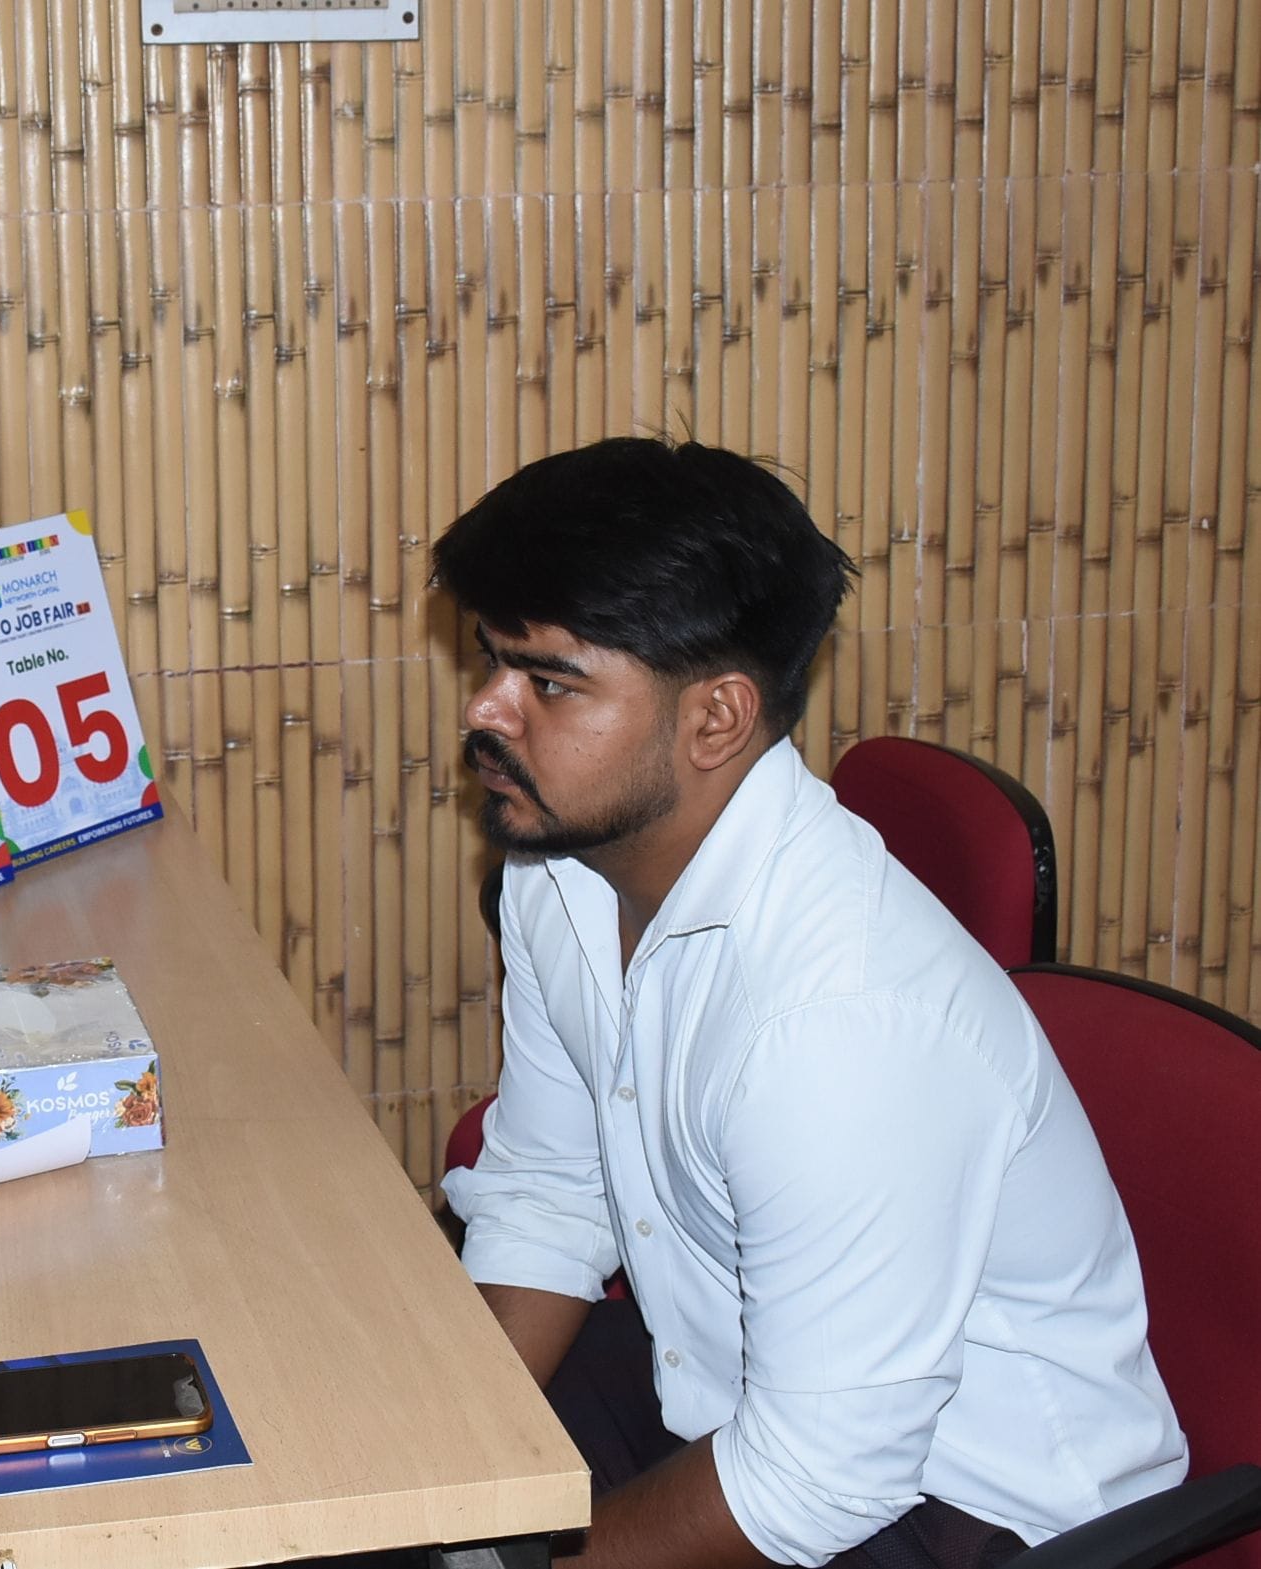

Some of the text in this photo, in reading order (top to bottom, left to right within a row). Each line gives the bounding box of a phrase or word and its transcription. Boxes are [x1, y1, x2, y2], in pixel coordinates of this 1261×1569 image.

[2, 570, 58, 594] MONARCH
[4, 585, 60, 605] NETWORTH CAPITAL
[15, 611, 43, 632] JOB
[43, 602, 75, 624] FAIR
[6, 648, 69, 676] Table No.
[77, 820, 123, 844] EMPOWERING
[25, 1091, 111, 1115] KOSMOS
